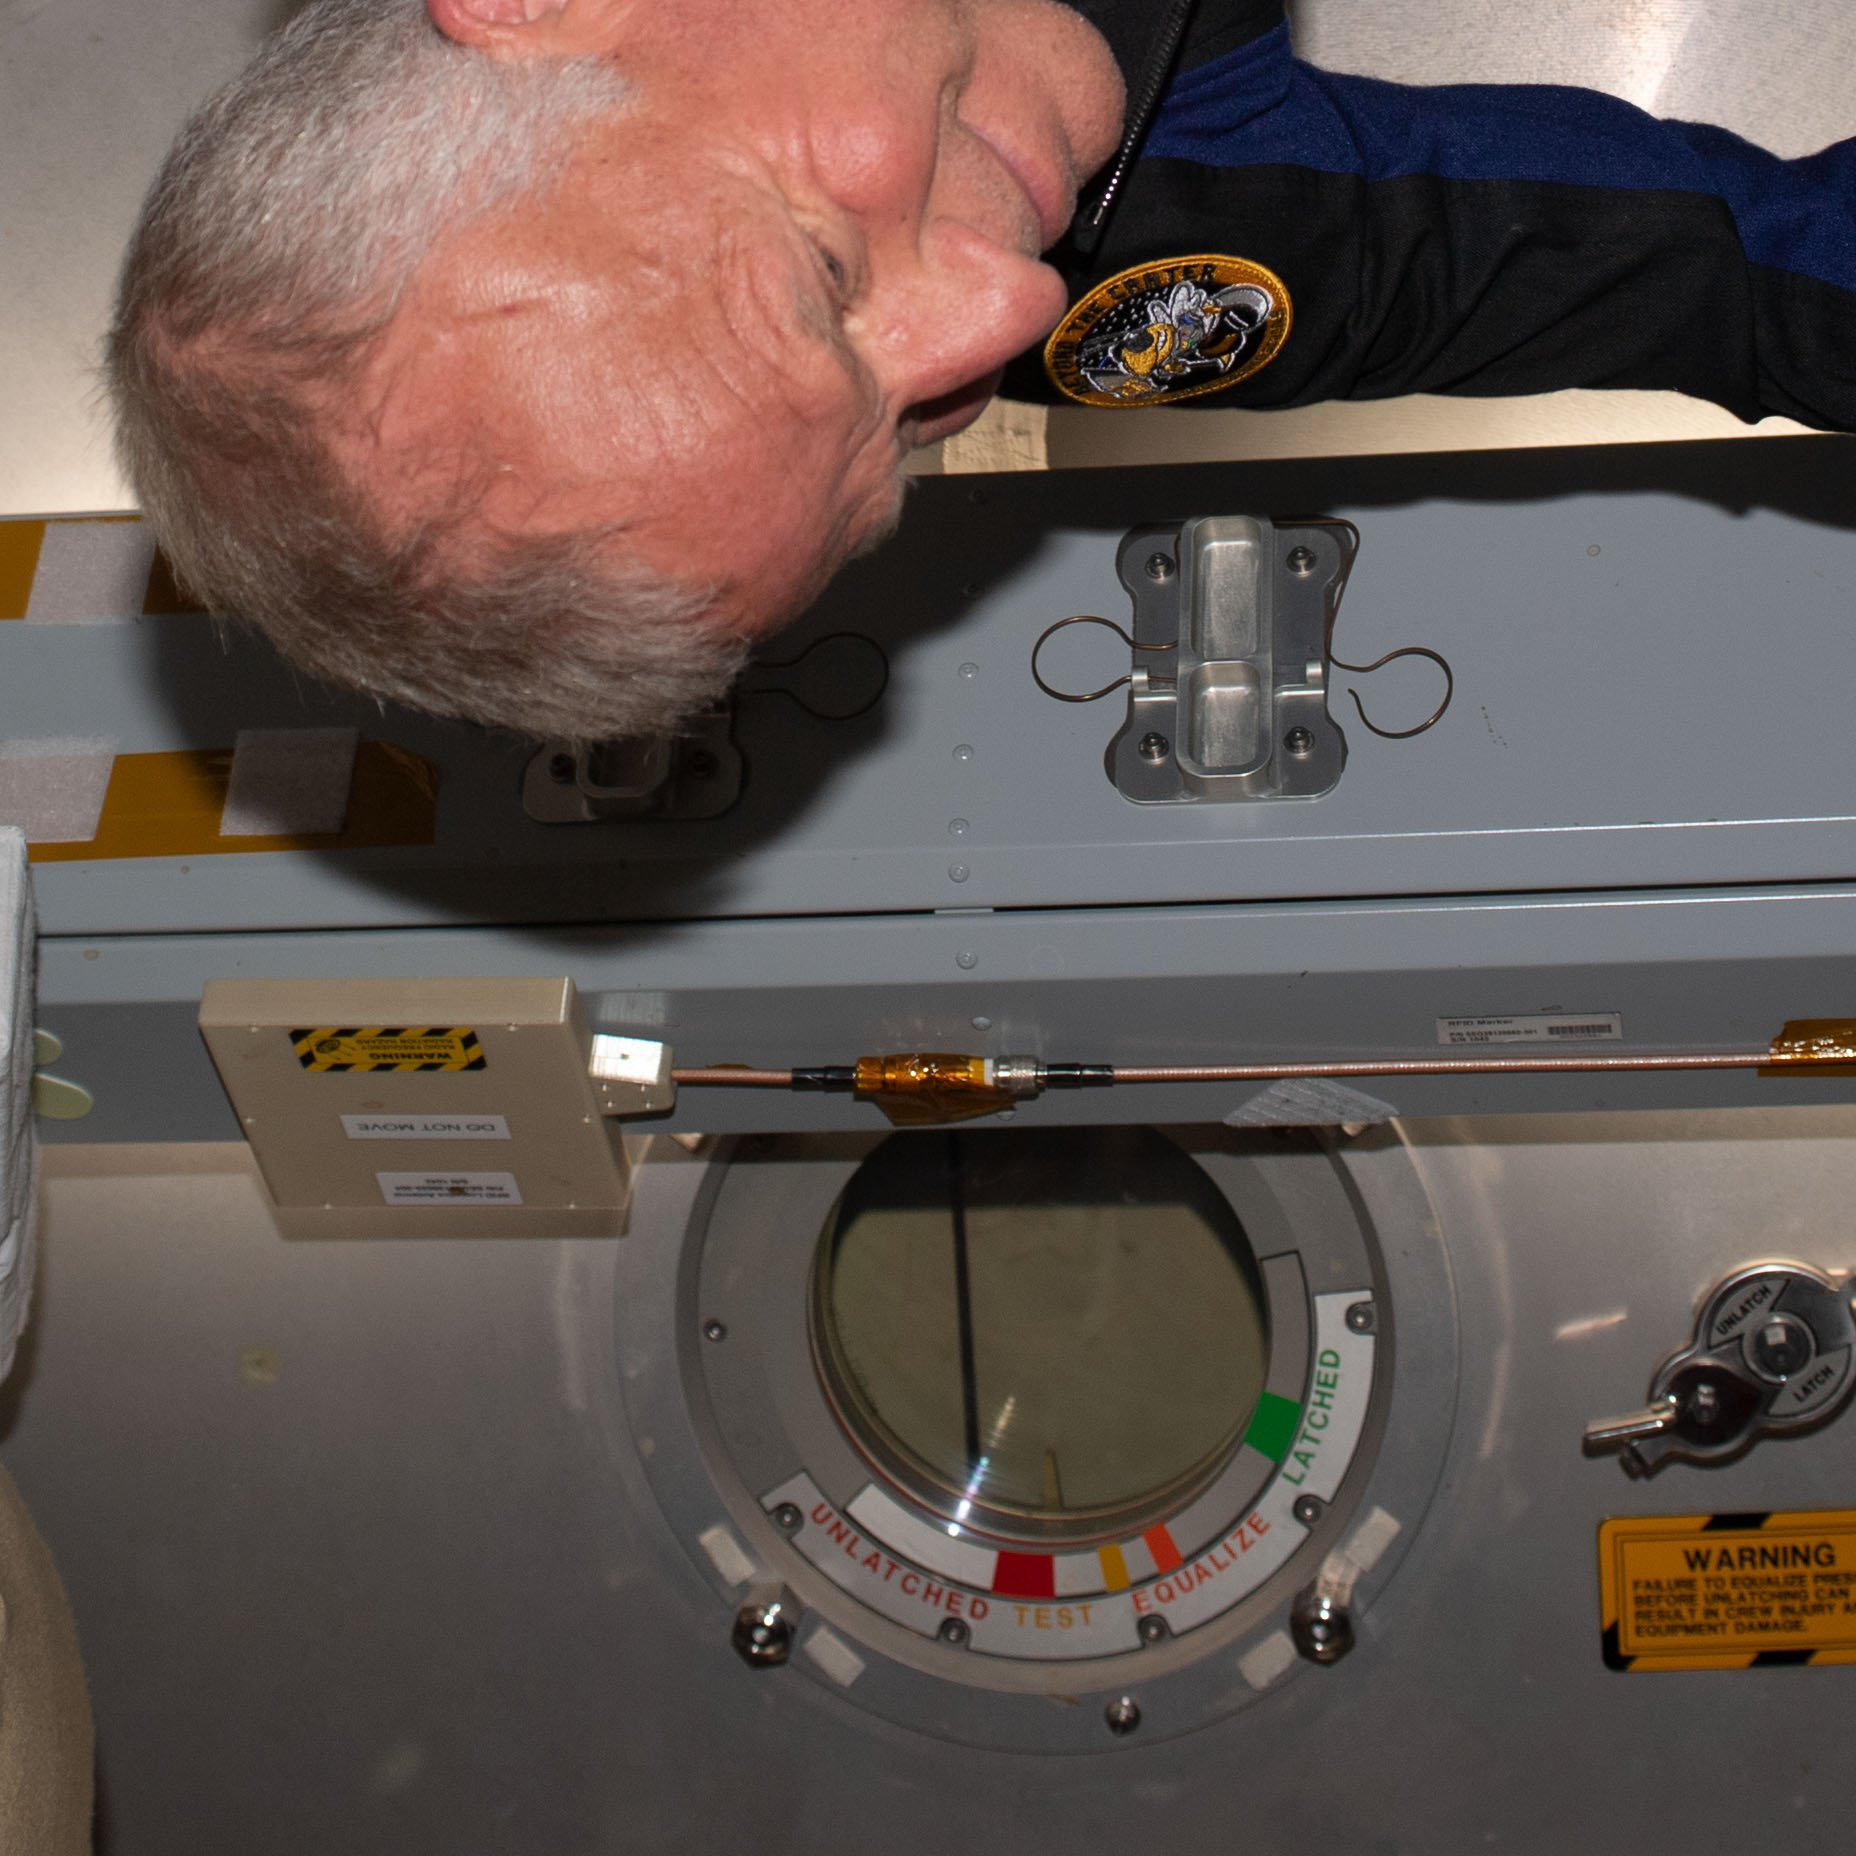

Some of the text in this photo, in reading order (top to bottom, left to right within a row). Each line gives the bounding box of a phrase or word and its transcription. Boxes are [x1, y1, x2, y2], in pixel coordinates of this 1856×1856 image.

[357, 1123, 495, 1132] DO NOT MOVE
[1716, 1285, 1771, 1336] UNLATCH
[1793, 1365, 1835, 1402] LATCH
[1282, 1348, 1341, 1486] LATCHED
[811, 1502, 989, 1620] UNLATCHED
[1130, 1511, 1272, 1613] EQUALIZE
[1683, 1542, 1836, 1572] WARNING
[1633, 1578, 1698, 1593] FAILURE
[1704, 1576, 1727, 1591] TO
[1731, 1575, 1807, 1590] EQUALIZE
[1634, 1588, 1850, 1608] BEFORE UNLATCHING CAN
[1012, 1604, 1093, 1629] TEST
[1635, 1608, 1697, 1623] RESULT
[1704, 1607, 1720, 1620] IN
[1725, 1605, 1774, 1620] CREW
[1780, 1603, 1836, 1618] INJURY
[1635, 1620, 1808, 1638] EQUIPMENT DAMAGE.
